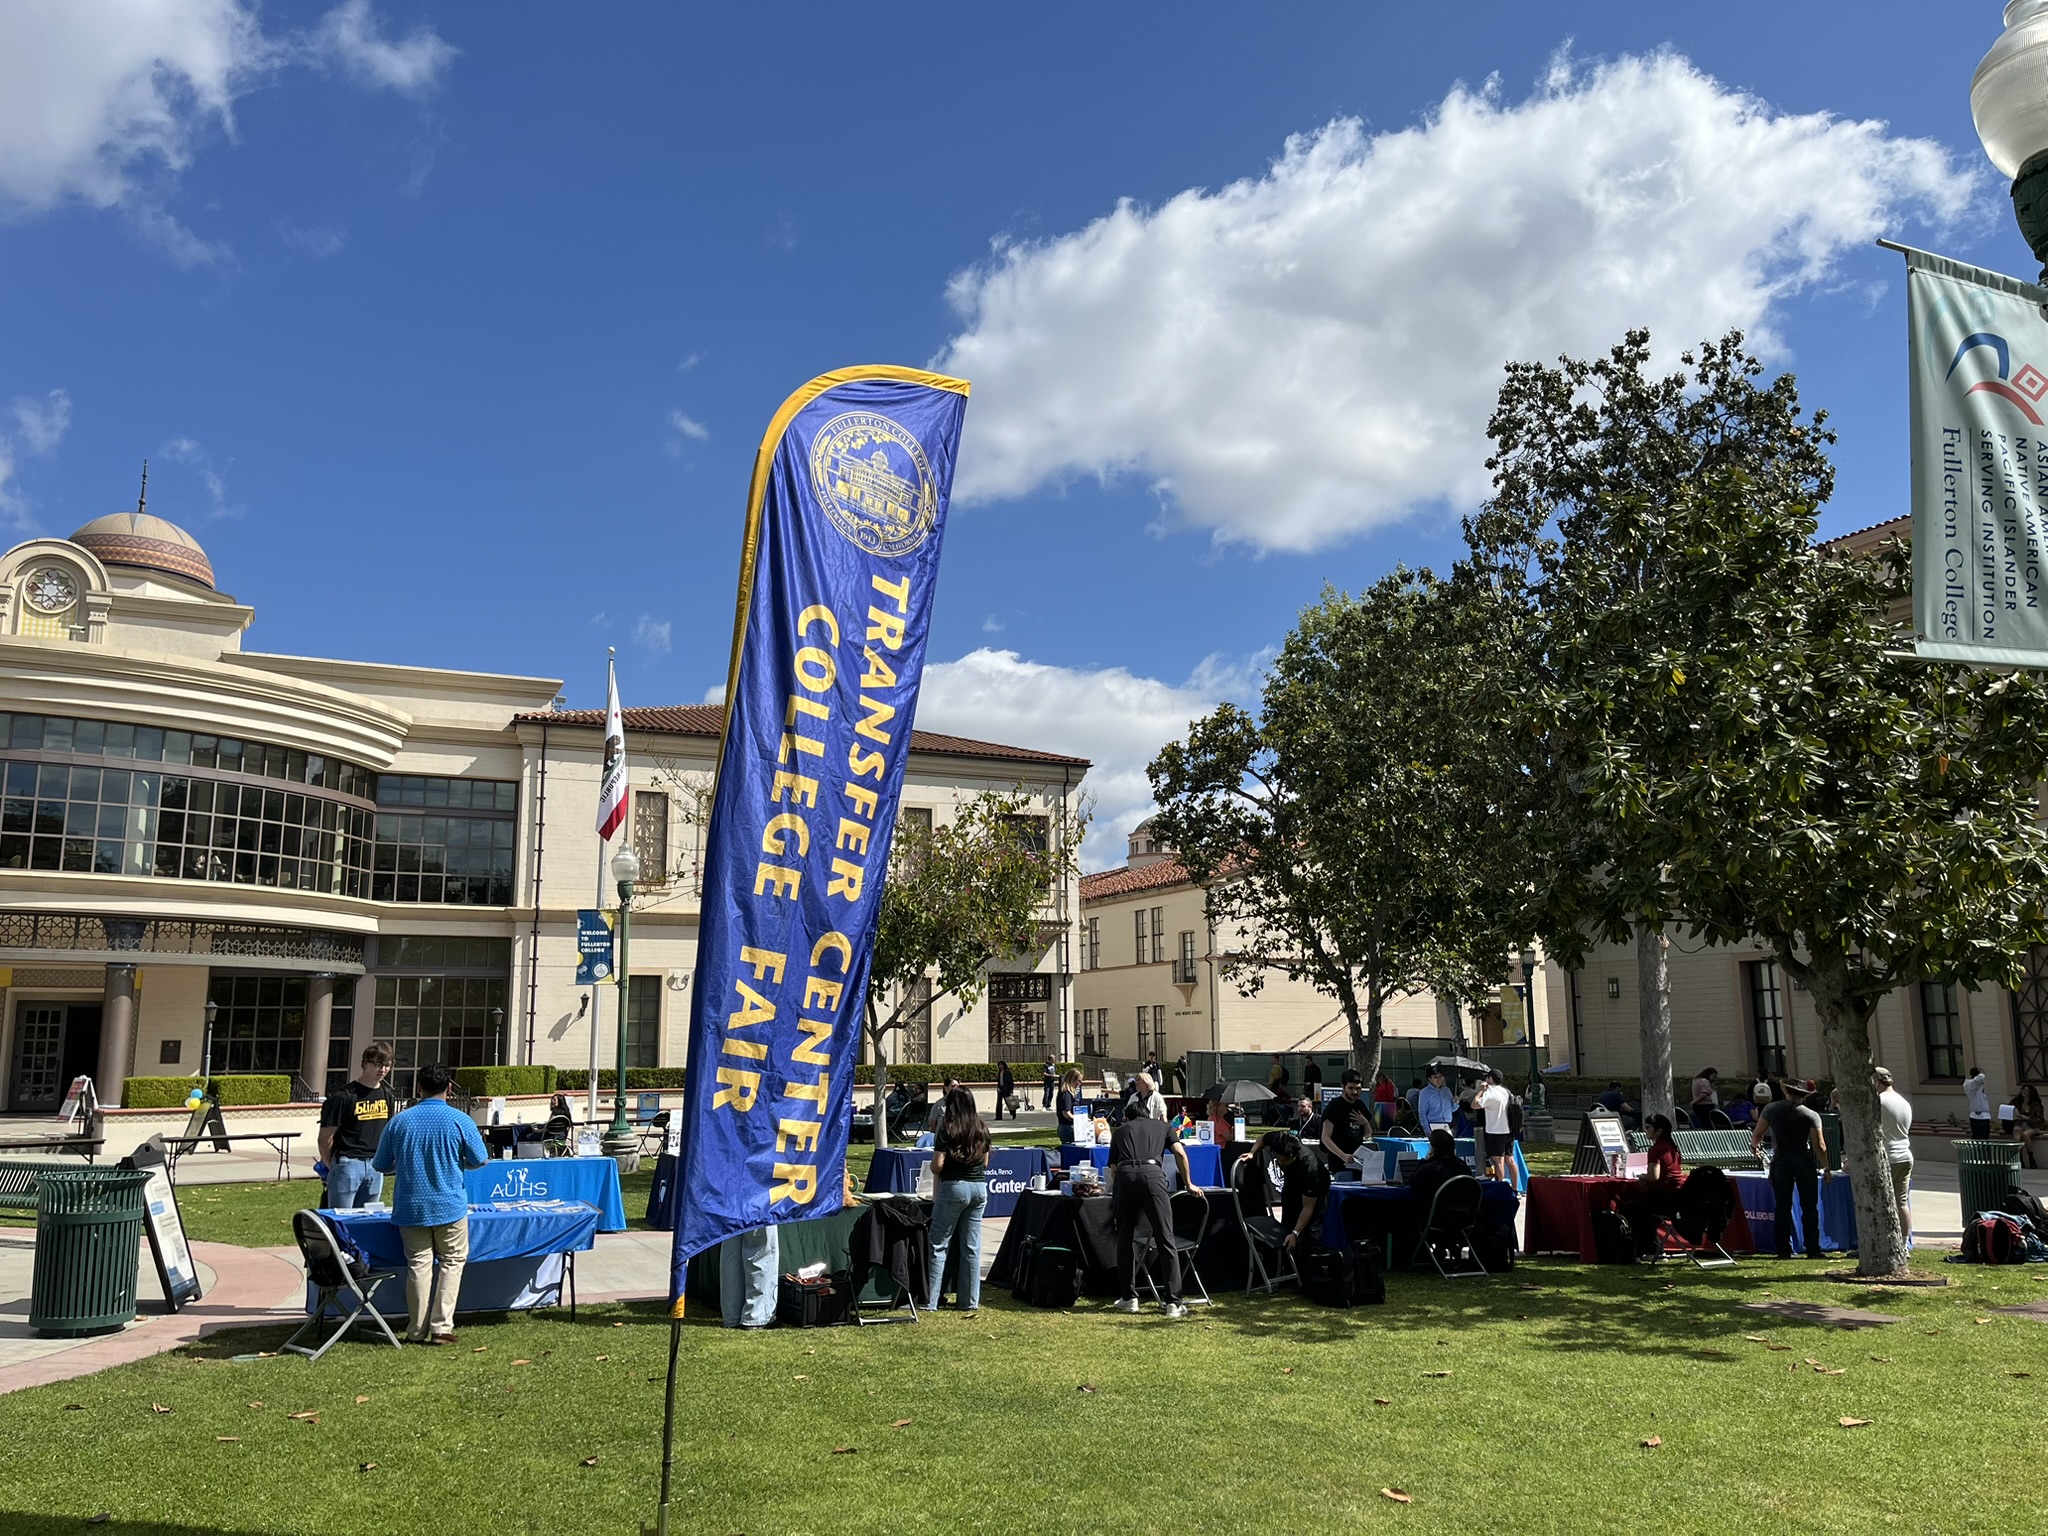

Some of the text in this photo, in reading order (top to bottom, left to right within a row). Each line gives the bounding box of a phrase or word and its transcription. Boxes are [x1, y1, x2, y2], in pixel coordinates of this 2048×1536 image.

[830, 416, 926, 471] FULLERTON COLLEGE
[2037, 440, 2048, 497] ASIAN
[860, 531, 876, 545] 1913
[1941, 426, 1965, 639] Fullerton College
[1981, 429, 1995, 639] SERVING INSTITUTION
[1998, 433, 2016, 611] PACIFIC ISLANDER
[2016, 437, 2039, 609] NATIVE AMERICAN
[712, 604, 840, 1113] COLLEGE FAIR
[769, 574, 910, 1206] TRANSFER CENTER
[490, 1181, 548, 1198] AUHS
[988, 1178, 1027, 1194] Center
[998, 1168, 1013, 1176] Reno
[1744, 1210, 1775, 1221] OLLEGE
